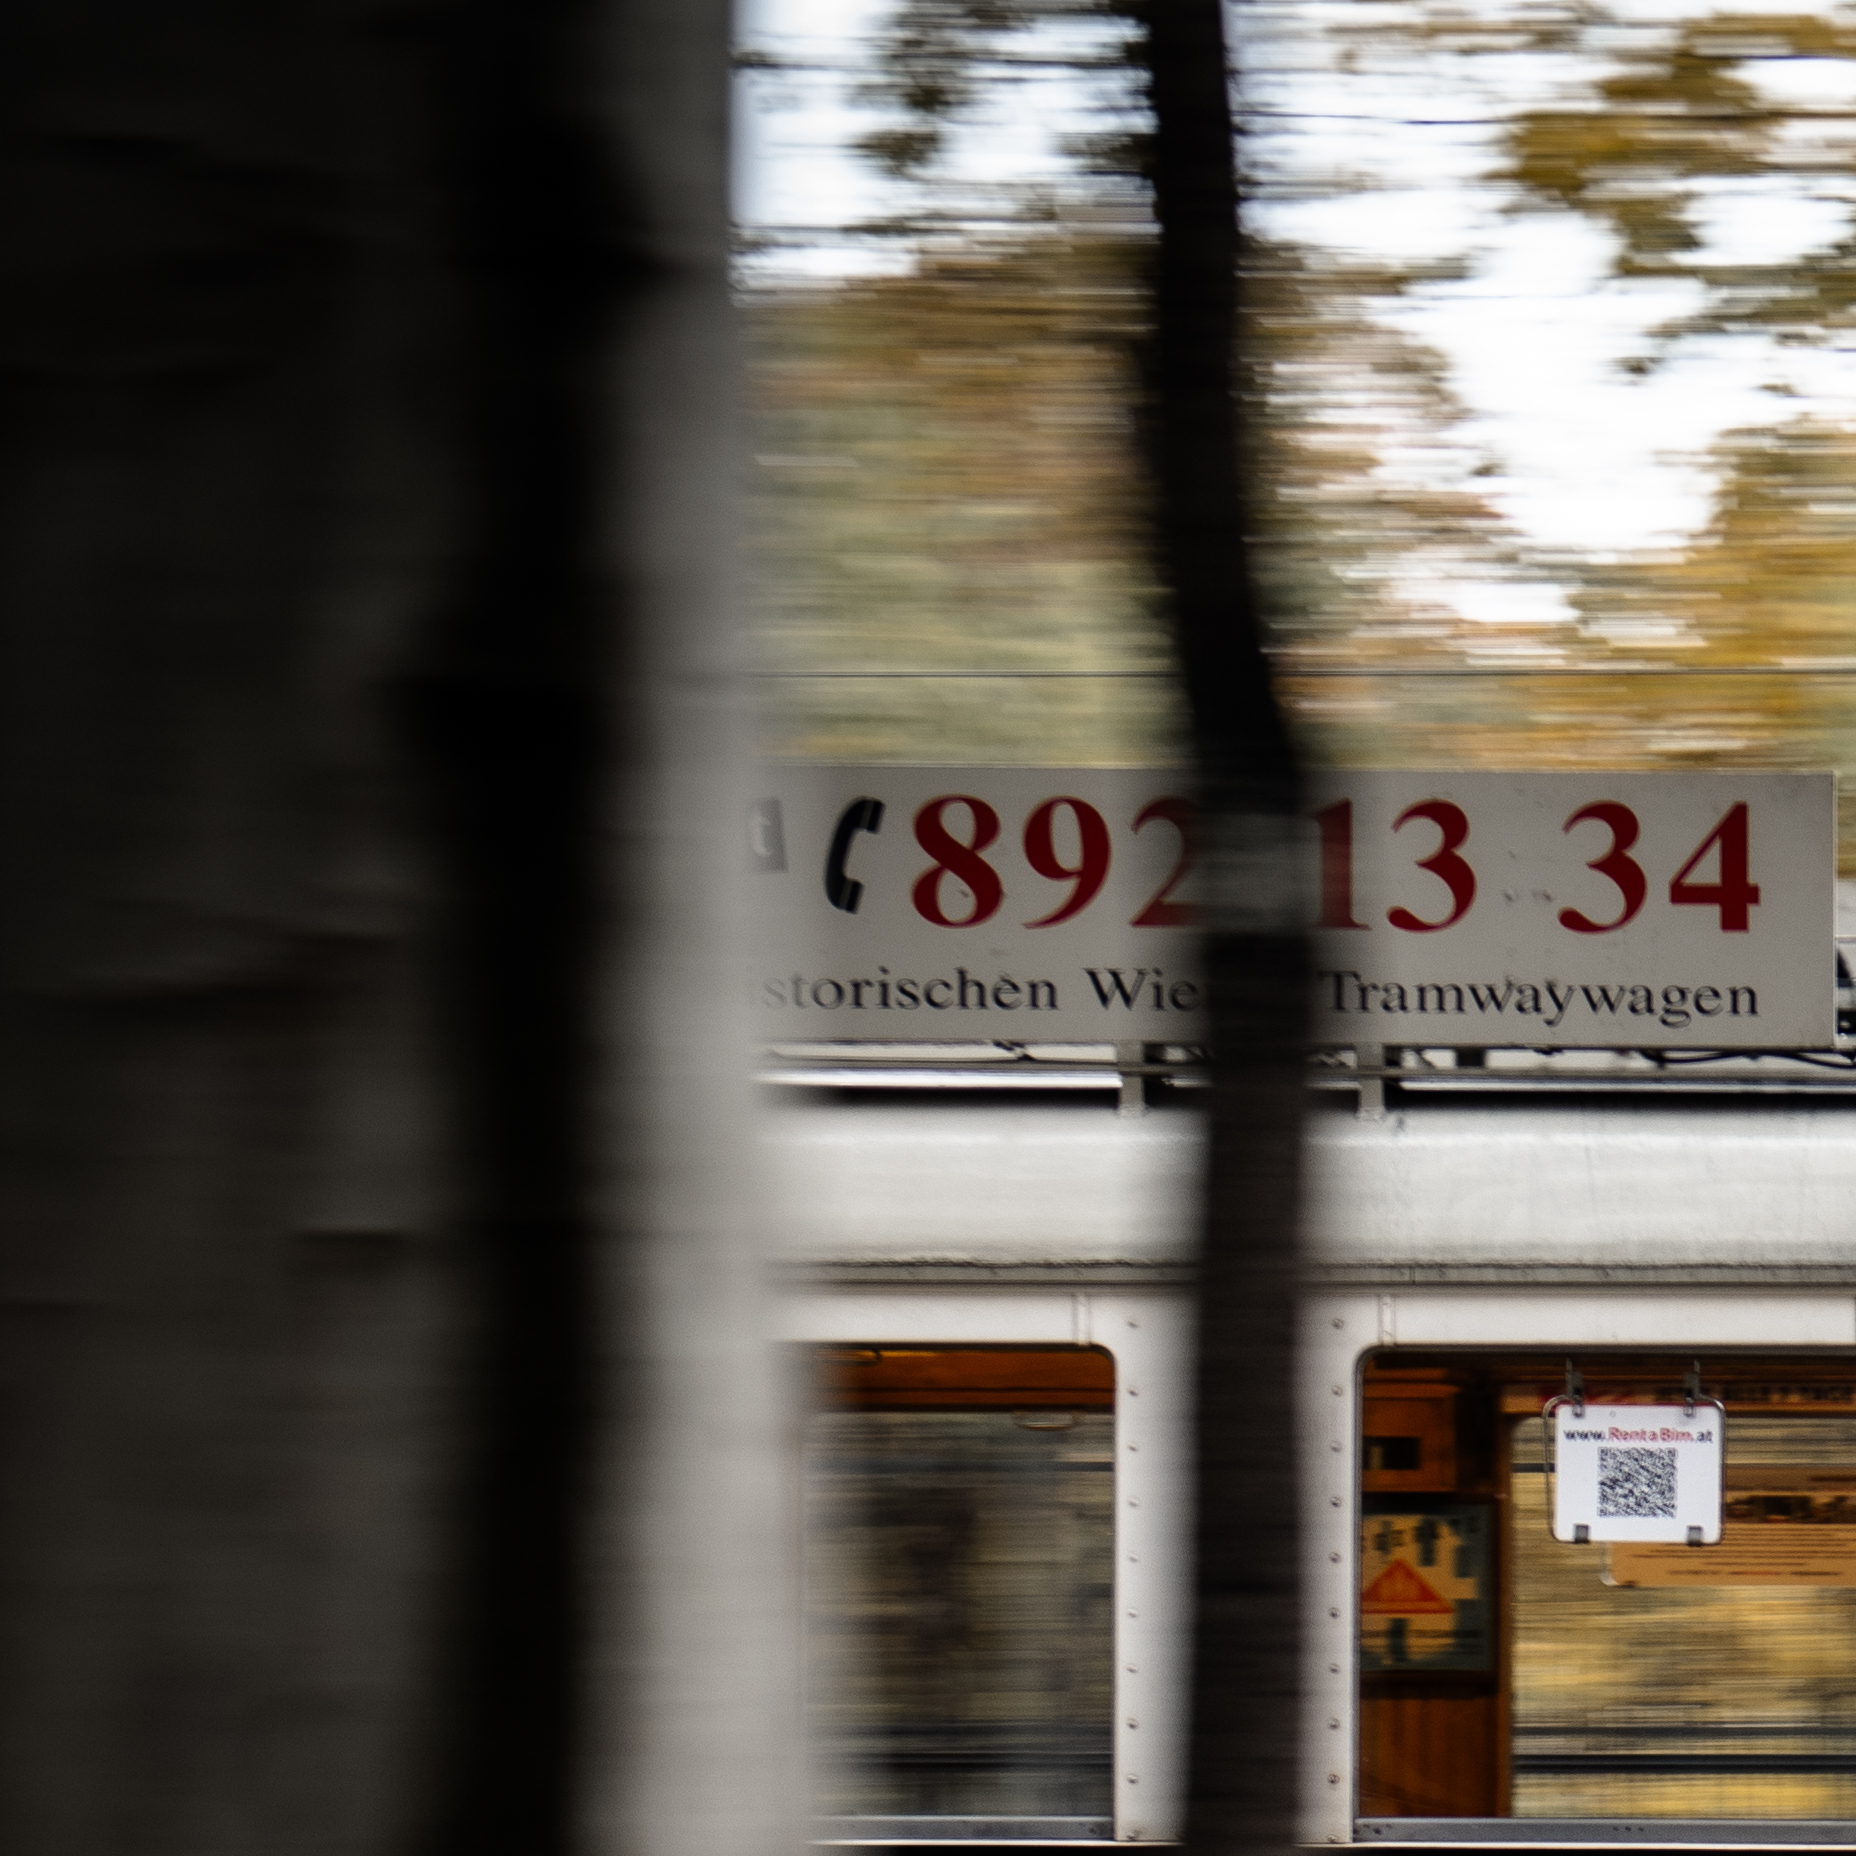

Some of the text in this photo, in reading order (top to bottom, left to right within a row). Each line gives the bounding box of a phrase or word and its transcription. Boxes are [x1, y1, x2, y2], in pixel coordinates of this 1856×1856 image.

[911, 794, 1207, 929] 892
[1309, 796, 1479, 933] 13
[1557, 798, 1761, 934] 34
[763, 964, 1760, 1028] storischen Wie Tramwaywagen
